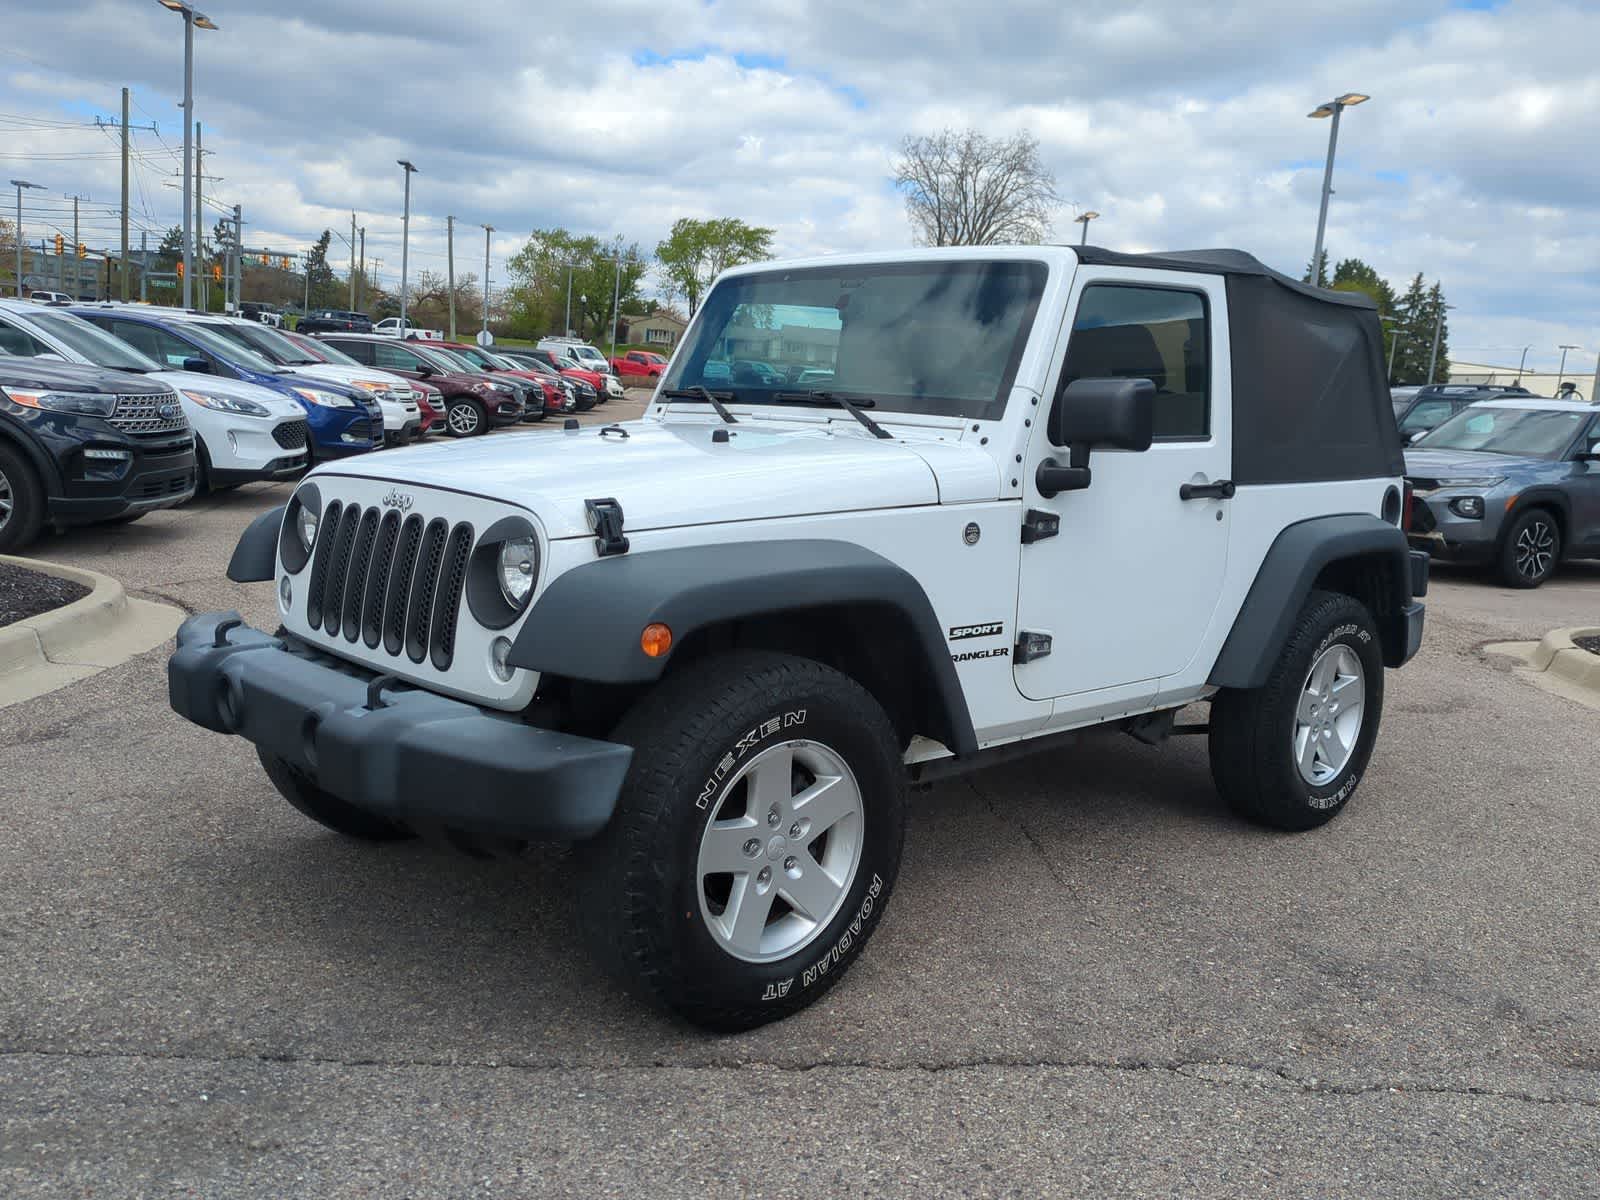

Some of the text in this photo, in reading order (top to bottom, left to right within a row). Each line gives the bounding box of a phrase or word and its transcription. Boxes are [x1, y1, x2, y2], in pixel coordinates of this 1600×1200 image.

[383, 488, 414, 512] Jeep
[950, 624, 1003, 638] SPORT
[951, 648, 1009, 662] RANGLER
[696, 709, 806, 810] NEXEN
[762, 873, 883, 1001] ROADIAN AT
